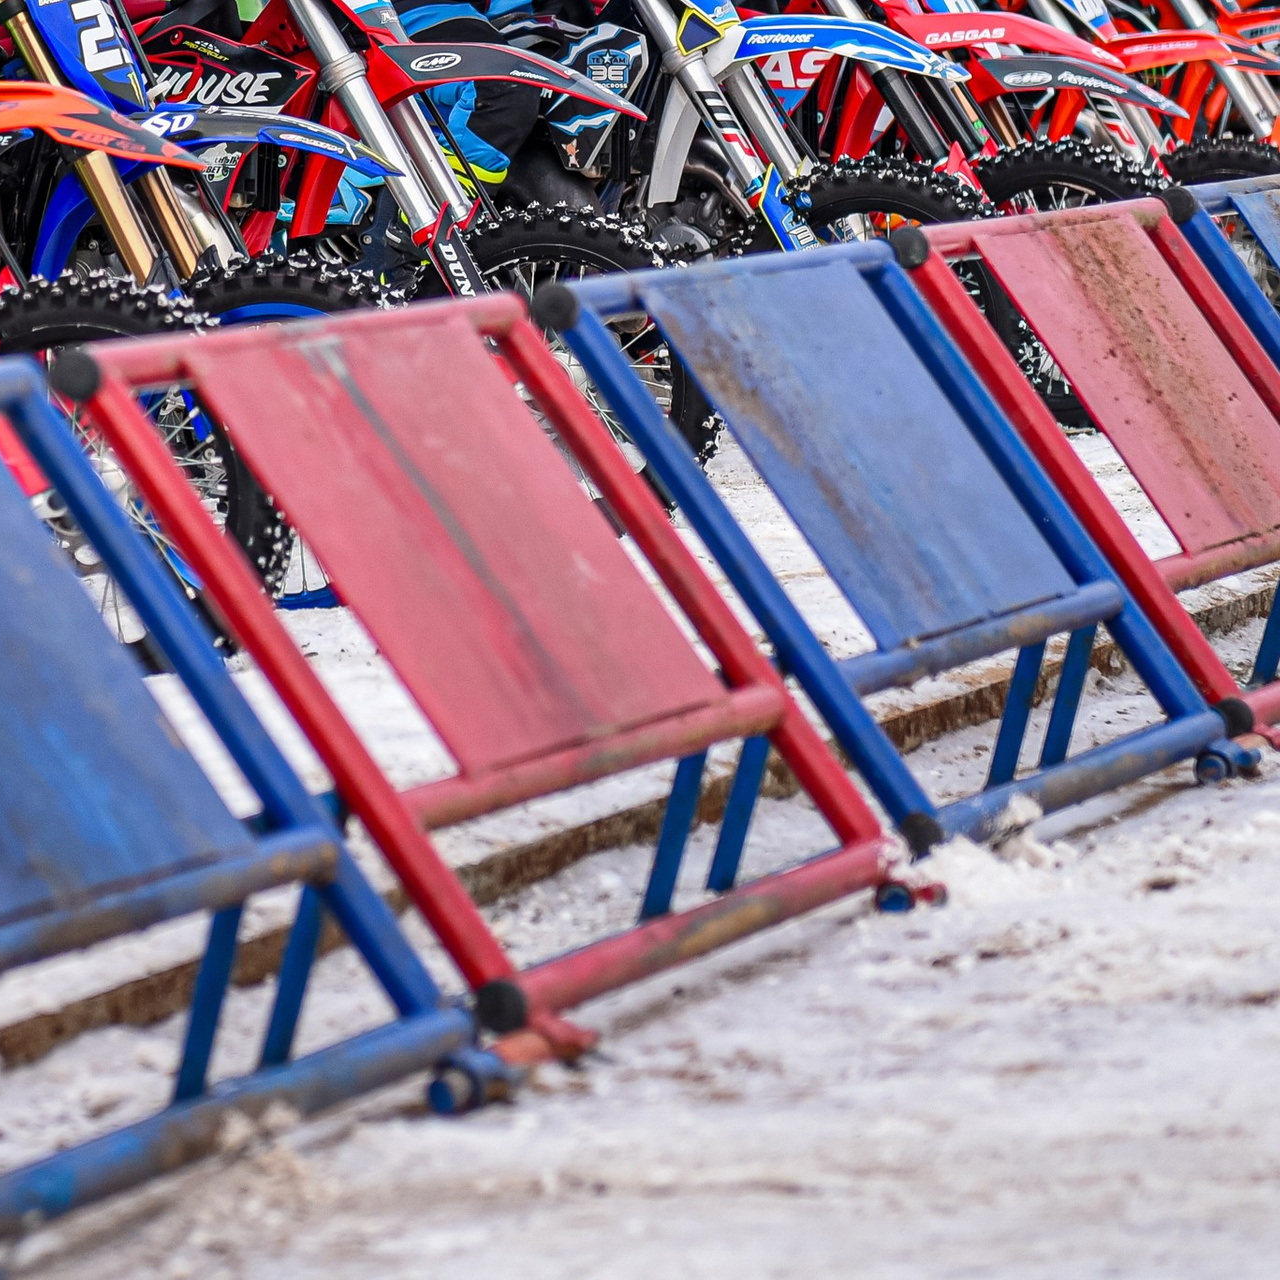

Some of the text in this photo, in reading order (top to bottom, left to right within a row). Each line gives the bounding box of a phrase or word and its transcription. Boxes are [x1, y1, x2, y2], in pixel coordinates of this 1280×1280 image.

[746, 32, 815, 45] FASTHOUSE
[924, 27, 1006, 46] GASGAS
[182, 39, 199, 51] PRO
[417, 55, 456, 70] FMF
